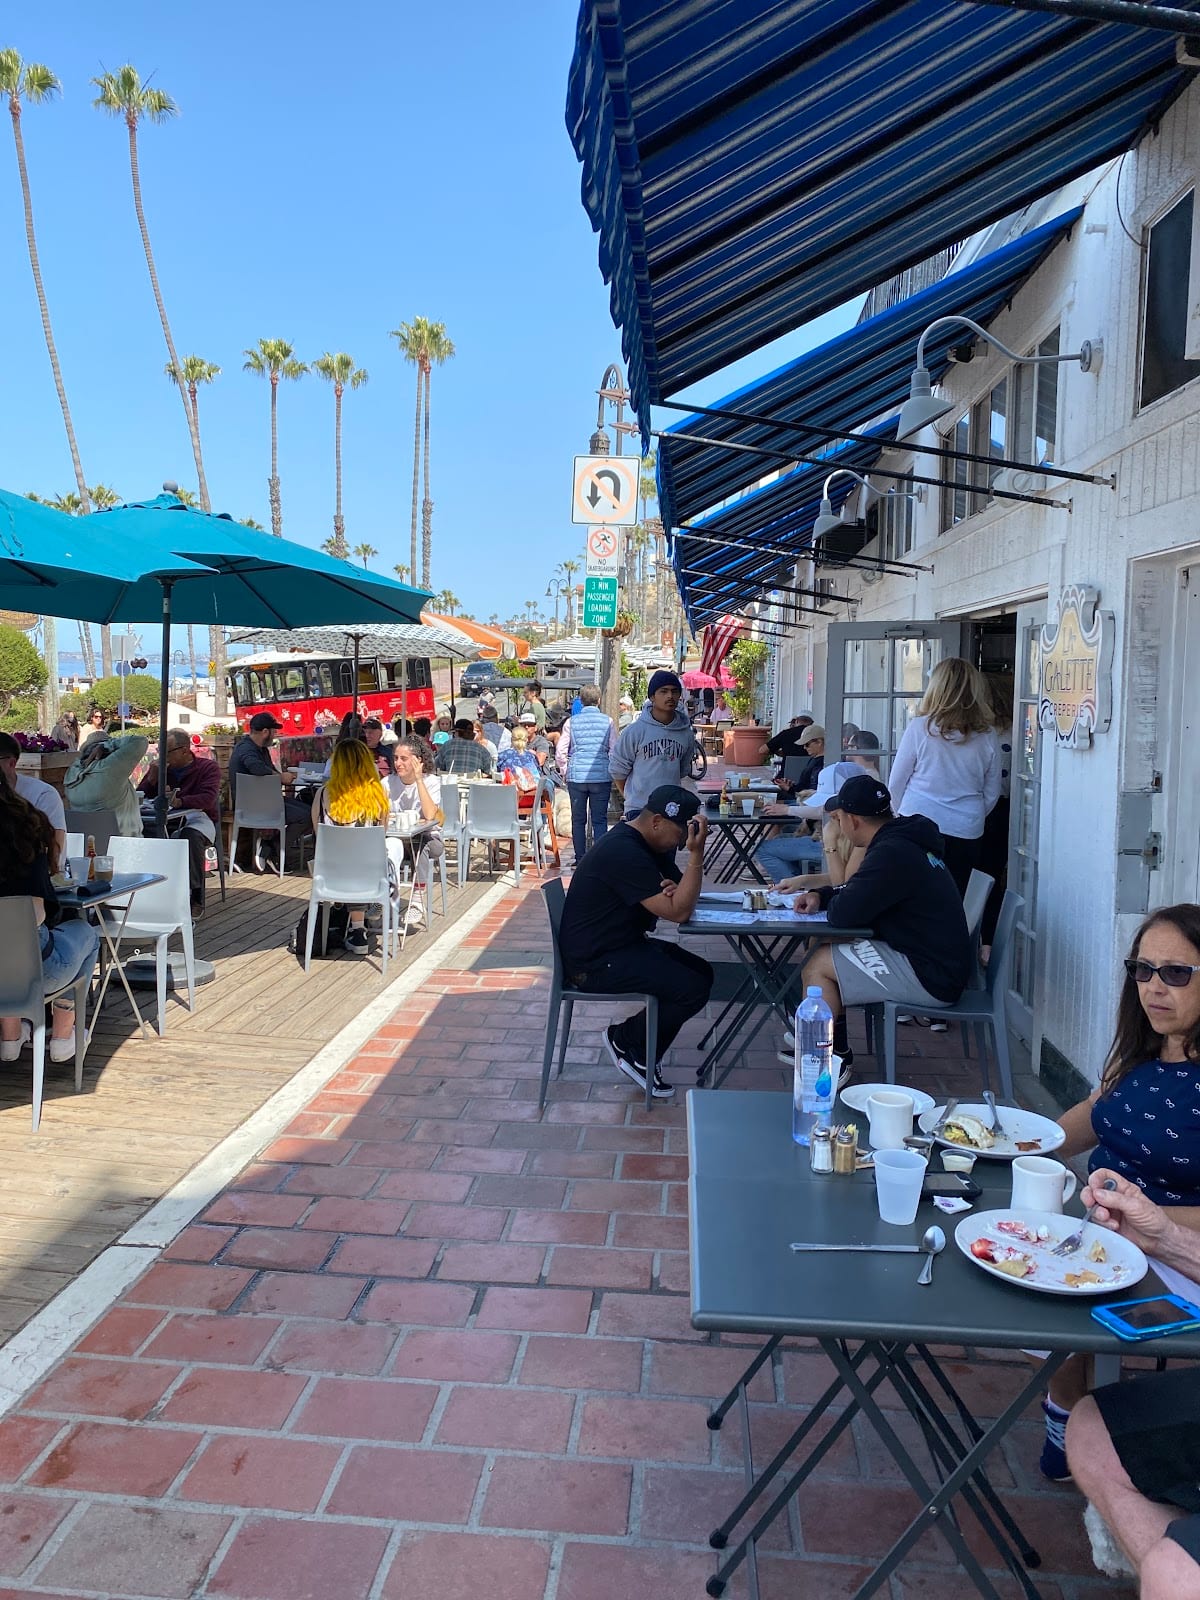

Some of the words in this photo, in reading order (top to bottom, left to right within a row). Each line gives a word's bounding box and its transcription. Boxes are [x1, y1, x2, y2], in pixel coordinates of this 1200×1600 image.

[591, 581, 596, 590] 3
[598, 581, 609, 590] MIN
[586, 592, 615, 602] PASSENGER
[587, 603, 612, 613] LOADING
[591, 614, 608, 624] ZONE
[1045, 658, 1094, 691] GALETTE
[1049, 702, 1085, 718] CREPERIE
[643, 738, 684, 760] PRIMITIV
[854, 939, 890, 977] NIKE
